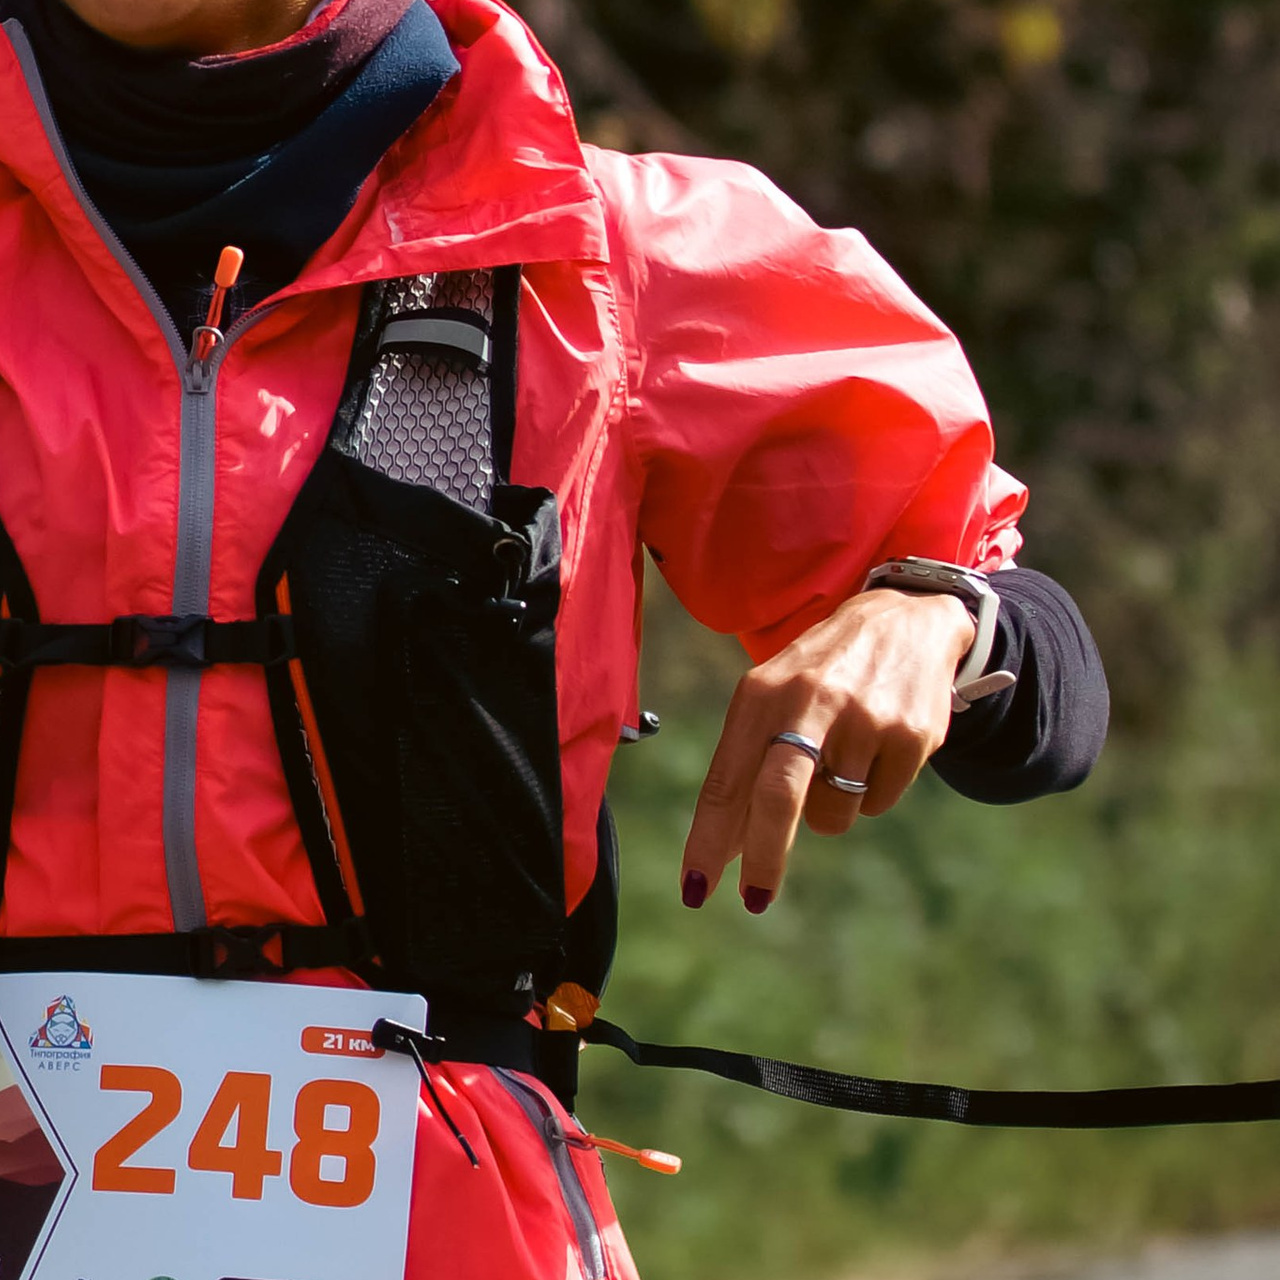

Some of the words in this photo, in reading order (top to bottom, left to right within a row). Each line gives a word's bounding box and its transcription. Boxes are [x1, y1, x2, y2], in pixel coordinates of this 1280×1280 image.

[323, 1032, 343, 1049] 21
[30, 1049, 91, 1059] Типография
[38, 1061, 81, 1071] АВЕРС
[93, 1064, 380, 1208] 248
